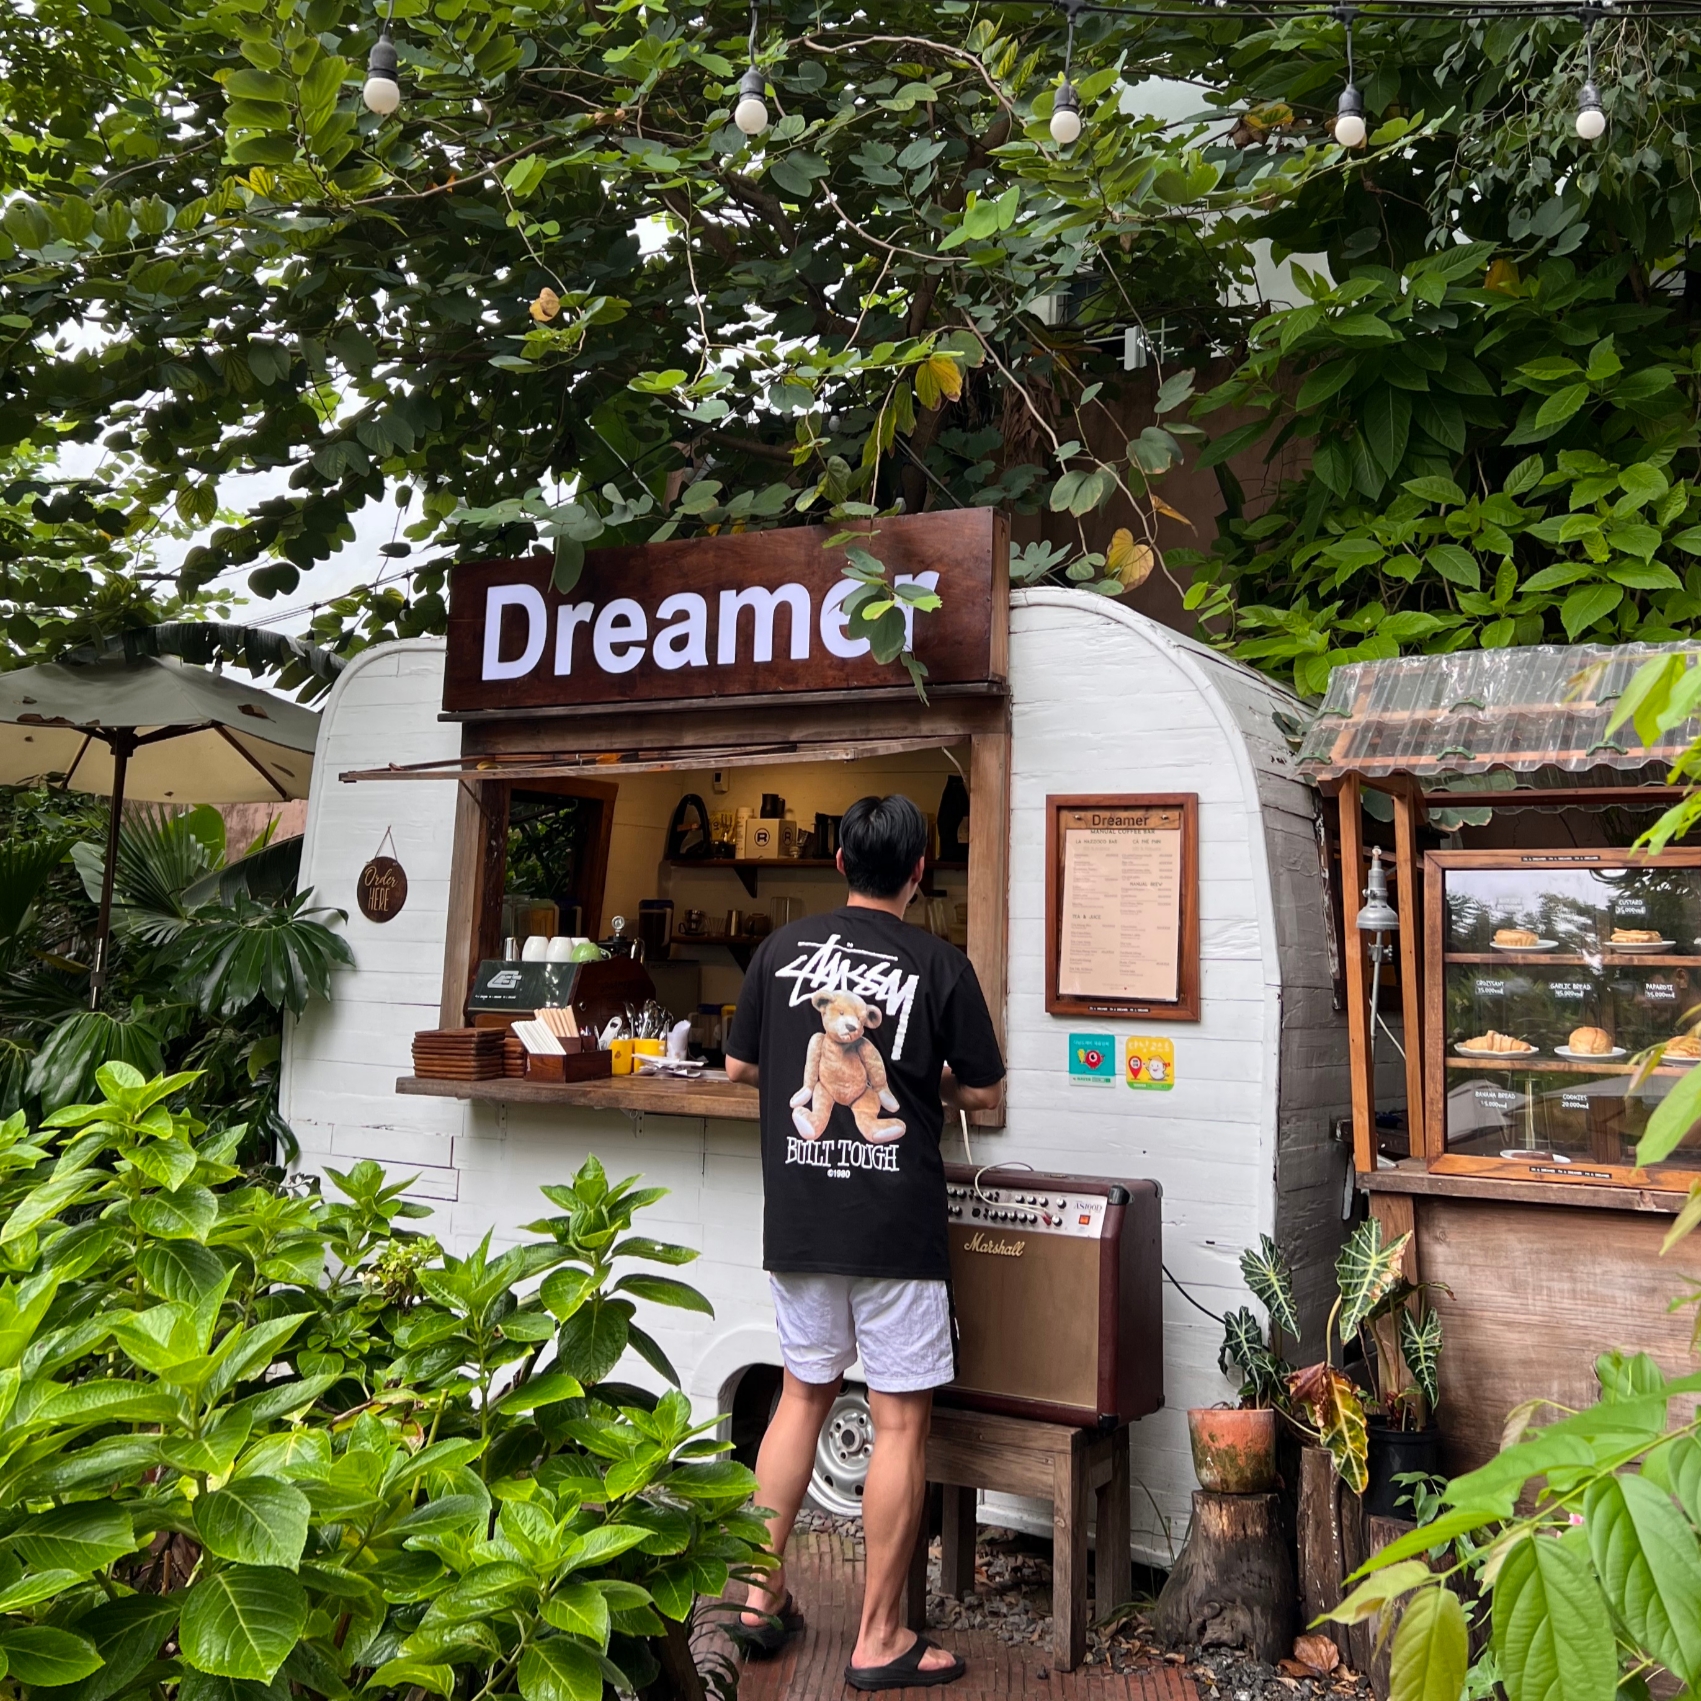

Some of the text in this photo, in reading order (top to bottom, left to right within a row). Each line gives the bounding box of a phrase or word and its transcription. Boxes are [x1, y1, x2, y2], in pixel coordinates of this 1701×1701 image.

[482, 570, 940, 681] Dreamer
[1092, 814, 1149, 826] Dreamer
[364, 865, 399, 888] Order
[368, 887, 390, 911] HERE
[1549, 982, 1591, 990] GARLIC BREAD
[1562, 1093, 1588, 1101] COOKIES
[785, 1136, 900, 1172] BUILT TOUGH
[963, 1232, 1026, 1257] Marshall
